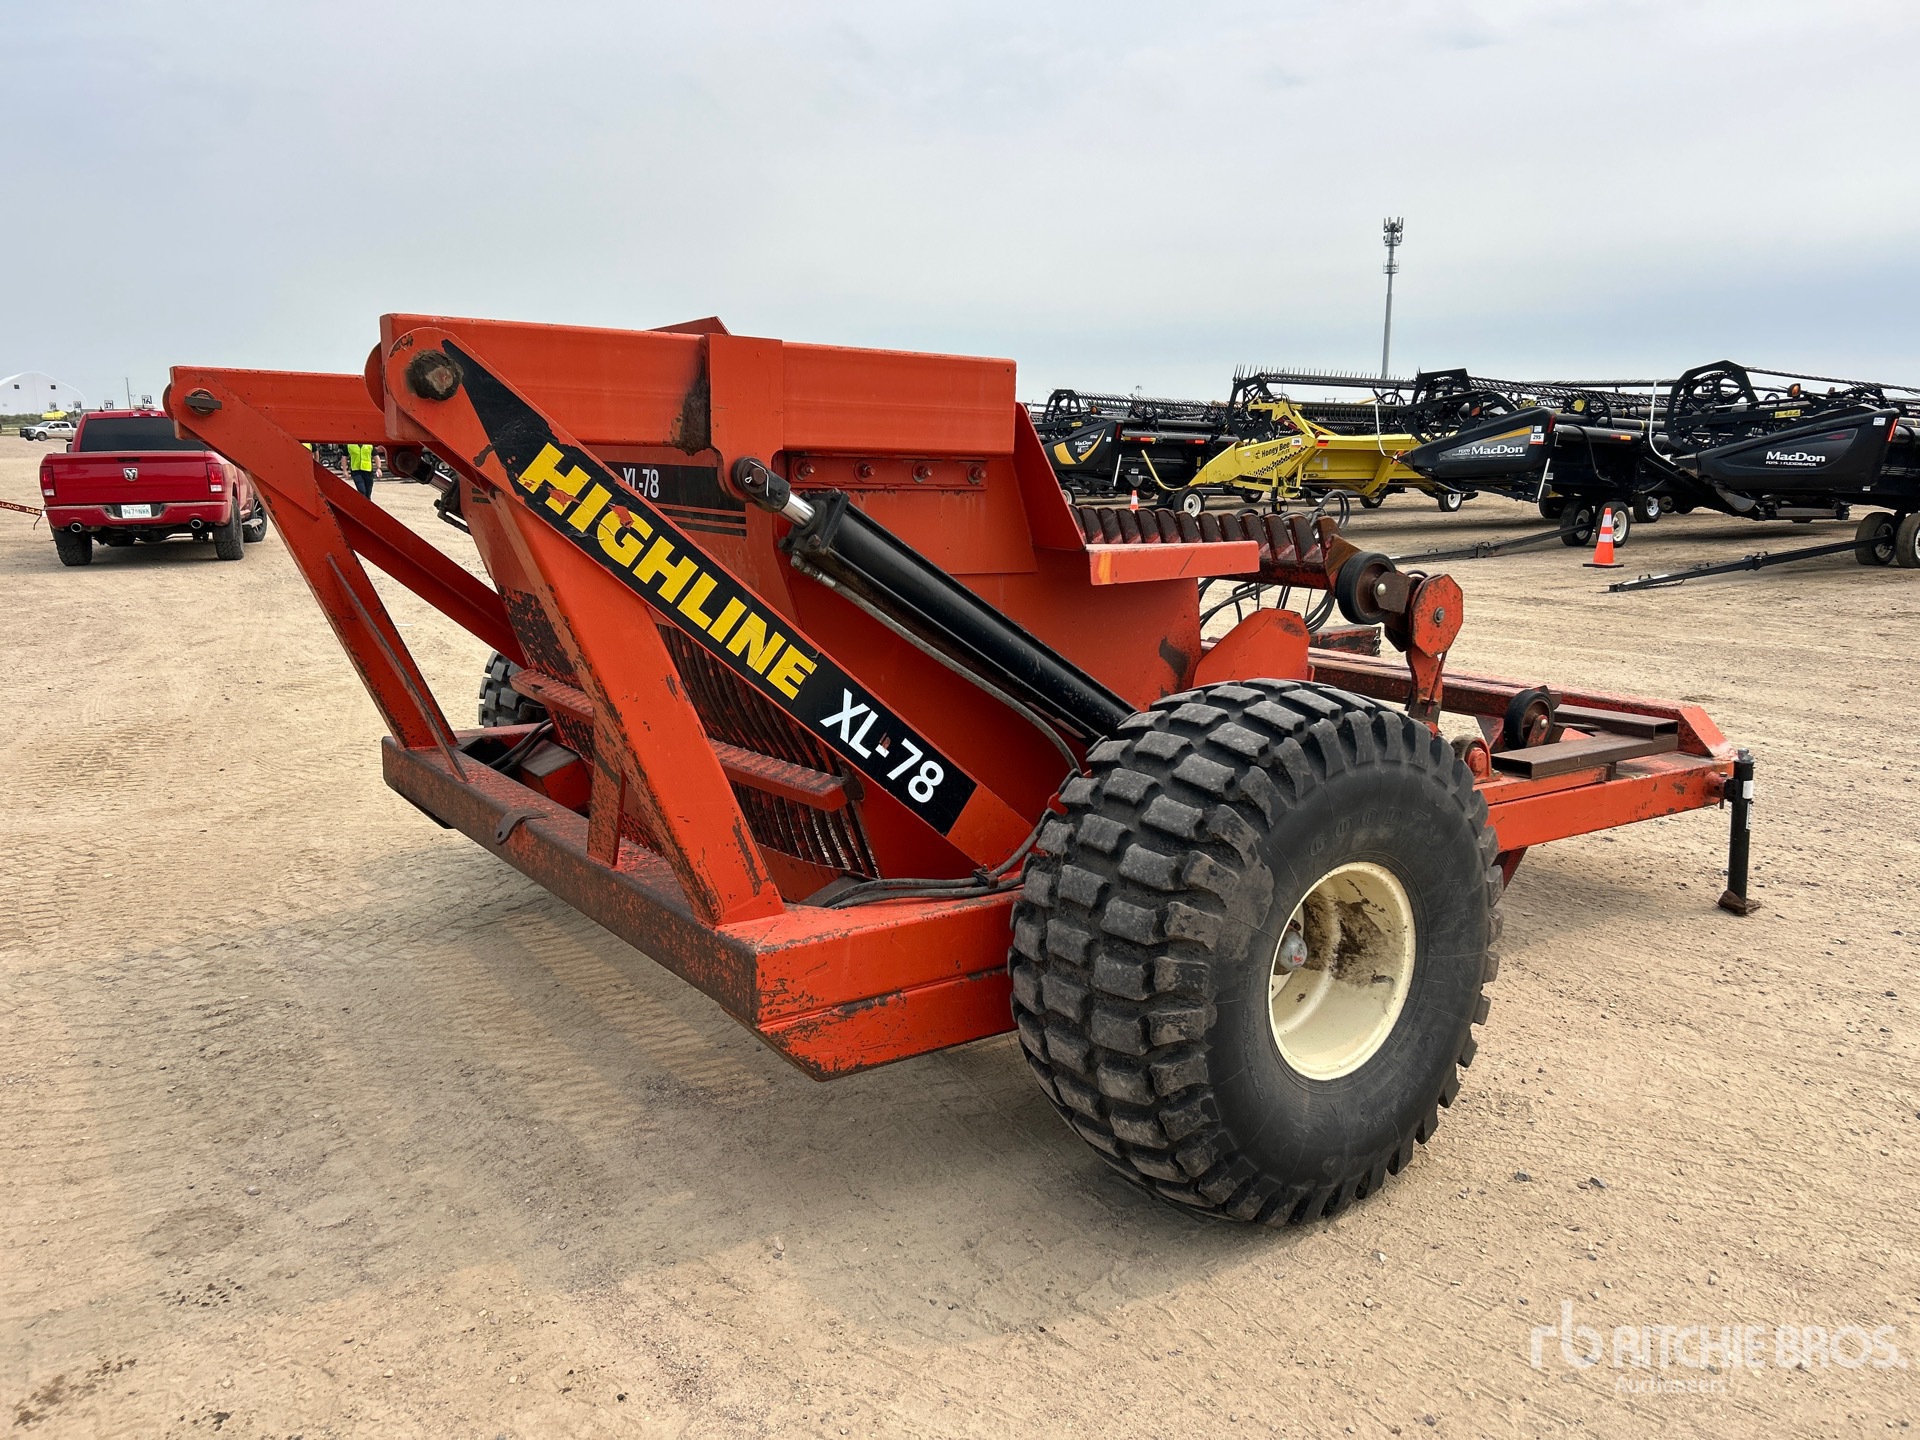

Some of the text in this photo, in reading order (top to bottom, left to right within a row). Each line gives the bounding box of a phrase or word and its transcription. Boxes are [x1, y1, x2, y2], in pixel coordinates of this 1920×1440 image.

[1261, 441, 1290, 458] Honey Bee
[1471, 444, 1524, 455] MacDon
[1766, 451, 1826, 463] MacDon
[622, 467, 660, 499] XL-78
[517, 442, 818, 700] HIGHLINE
[819, 687, 945, 804] XL-78
